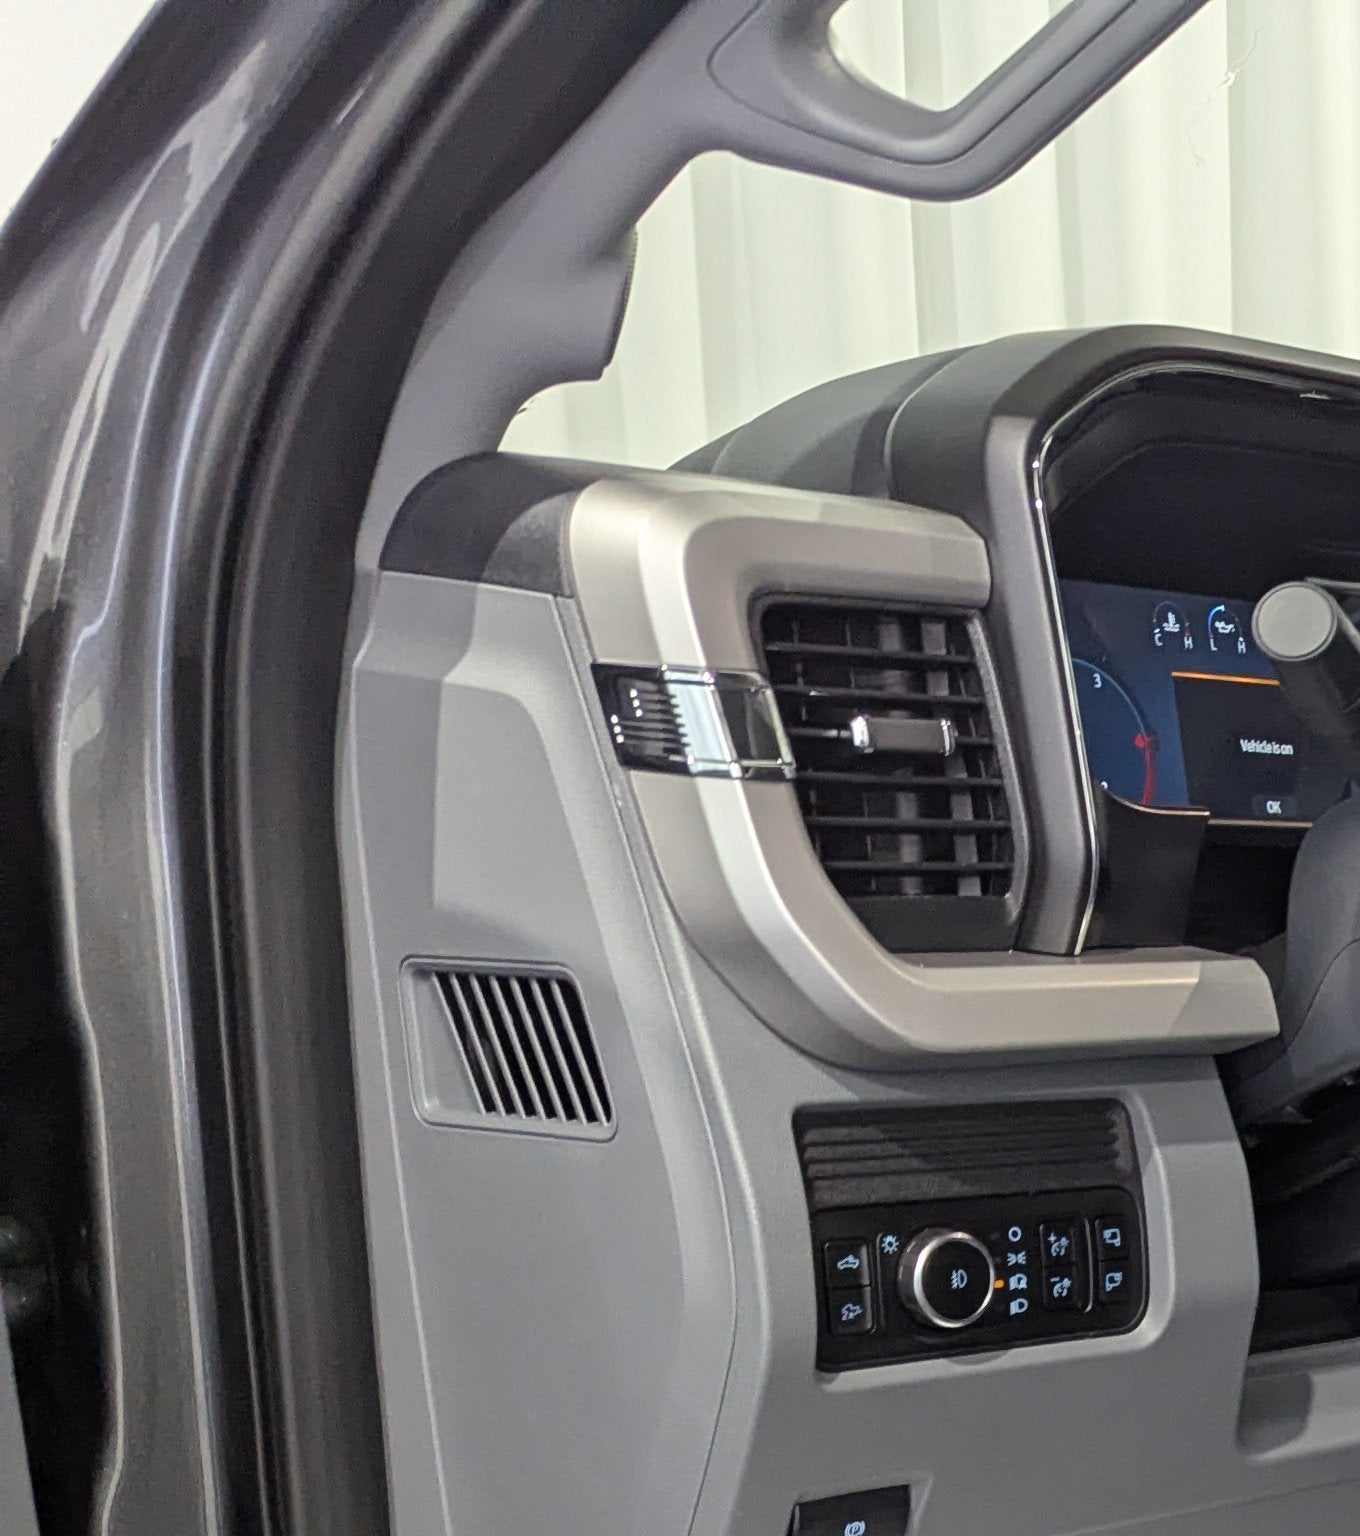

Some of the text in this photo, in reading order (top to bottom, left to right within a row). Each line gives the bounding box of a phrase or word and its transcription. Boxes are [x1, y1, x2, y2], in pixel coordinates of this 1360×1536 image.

[1093, 673, 1102, 689] 3
[1240, 739, 1294, 756] Vehicle is on
[1266, 800, 1282, 814] OK
